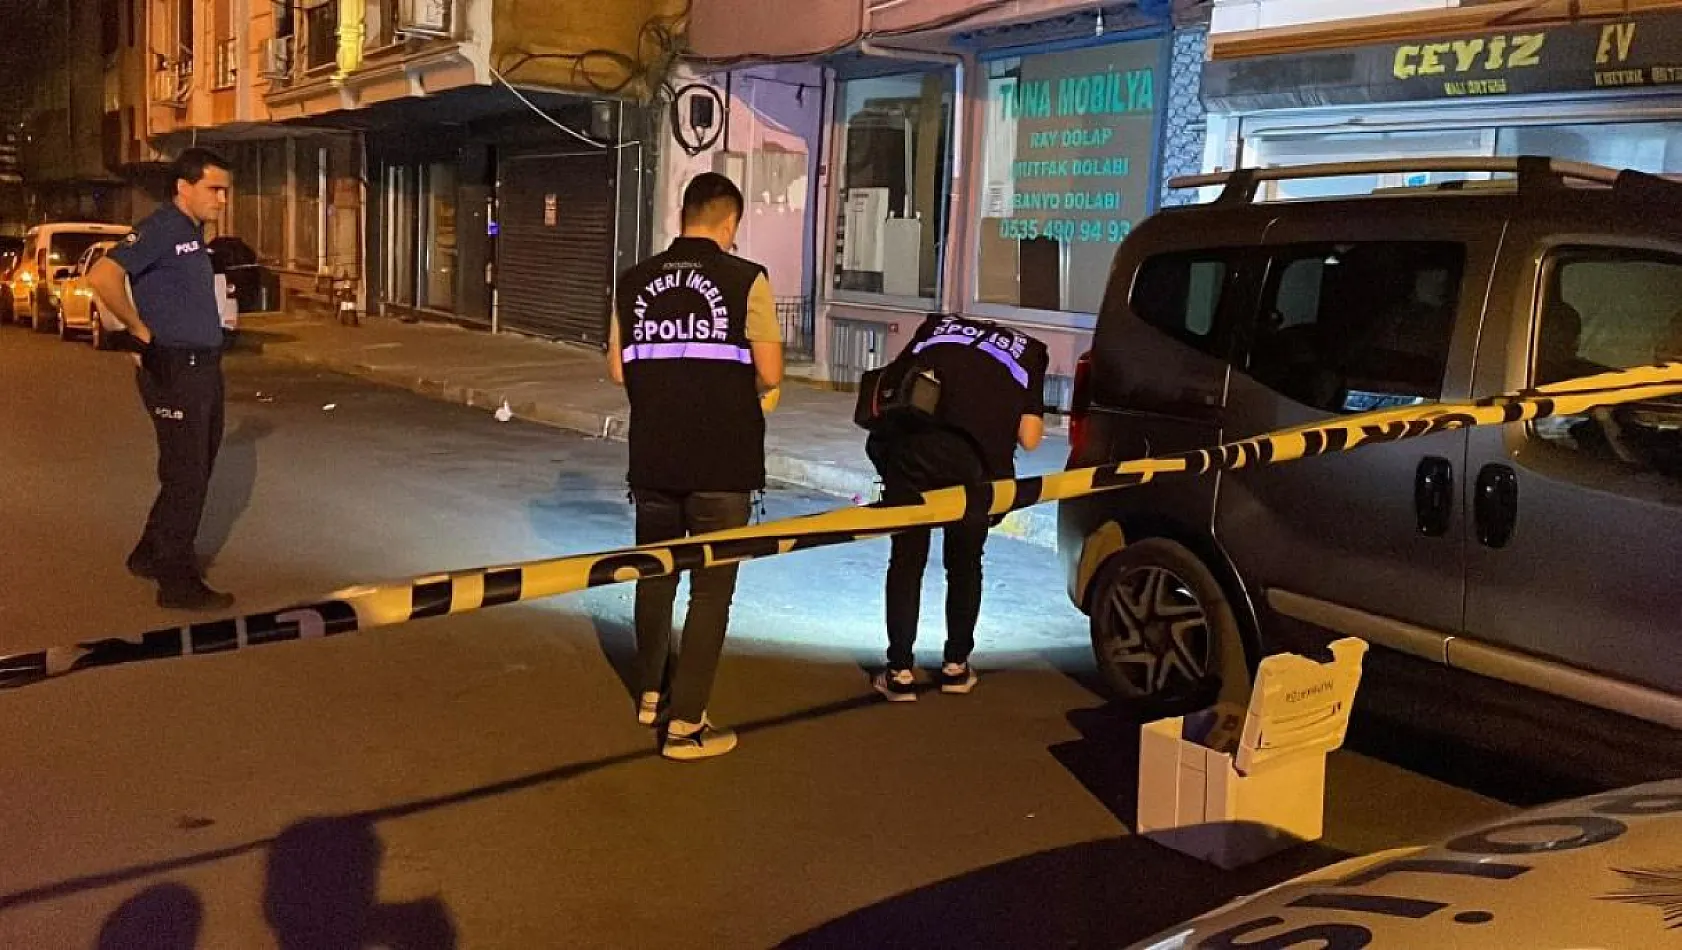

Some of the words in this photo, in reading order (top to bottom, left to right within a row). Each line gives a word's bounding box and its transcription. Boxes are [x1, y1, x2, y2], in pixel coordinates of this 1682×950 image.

[1596, 22, 1636, 64] EV
[1001, 79, 1050, 120] TUNA
[1058, 64, 1153, 117] MOBİLYA
[1030, 130, 1058, 148] RAY
[1062, 127, 1113, 147] DOLAP
[1011, 160, 1068, 178] MUTFAK
[1073, 157, 1129, 176] DOLABI
[1010, 192, 1060, 210] BANYO
[1064, 191, 1120, 210] DOLABI
[1001, 218, 1038, 240] 0535
[1080, 219, 1103, 242] 94
[633, 295, 649, 341] OLAY
[645, 312, 710, 341] POLİS
